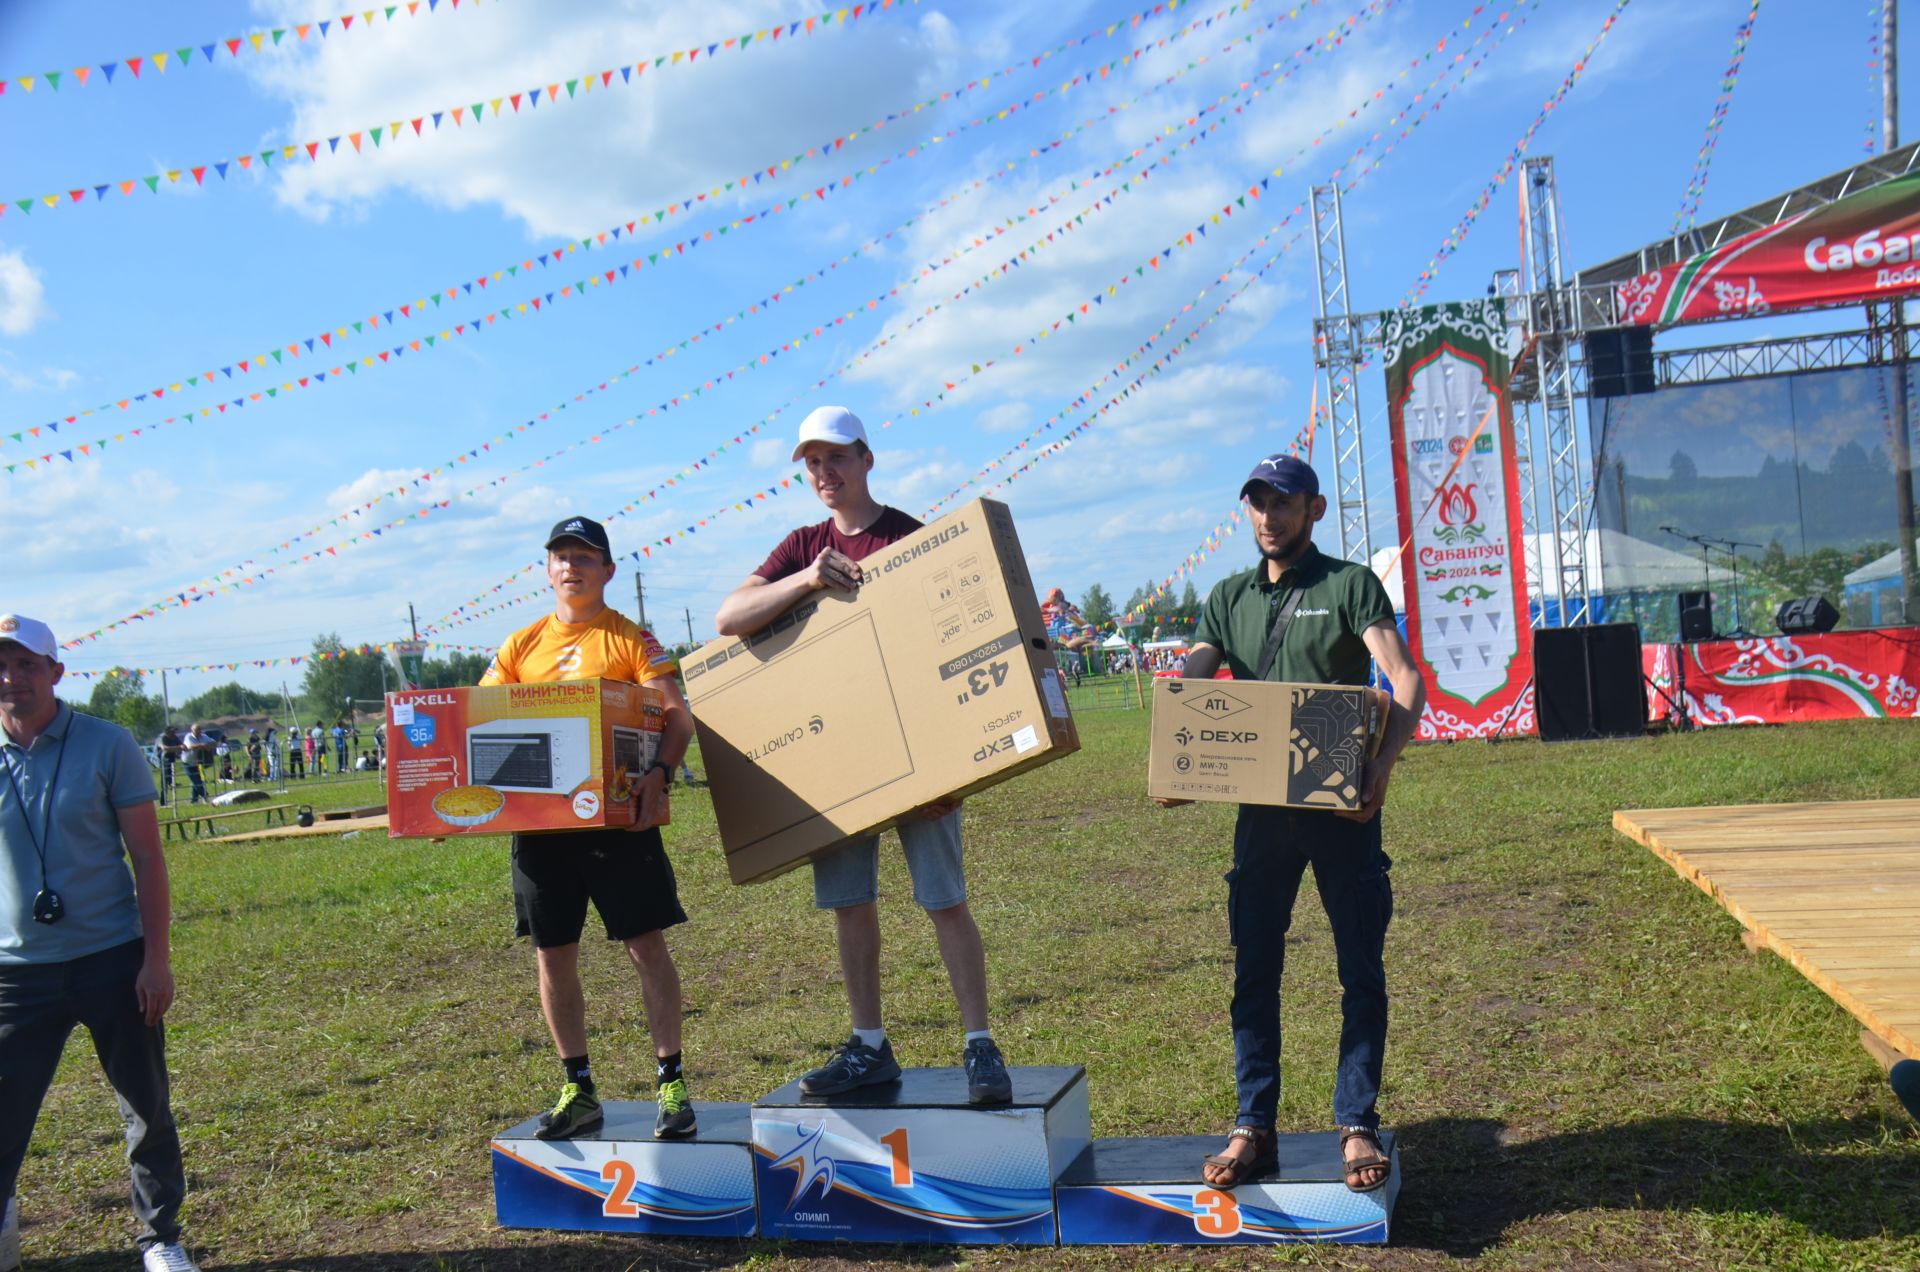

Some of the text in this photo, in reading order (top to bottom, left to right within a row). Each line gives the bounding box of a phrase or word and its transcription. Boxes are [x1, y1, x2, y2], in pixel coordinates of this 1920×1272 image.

[883, 520, 969, 573] ТЕЛЕВИЗОР
[1419, 537, 1504, 567] Сабантуй
[862, 566, 881, 584] LE
[1450, 566, 1477, 578] 2024
[971, 608, 995, 625] 100+
[948, 641, 1004, 673] 1920x1080
[957, 661, 1009, 705] 43"
[511, 695, 596, 708] ЭЛЕКТРИЧЕСКАЯ
[1205, 698, 1229, 711] ATL
[983, 709, 1022, 734] 43FCS1
[762, 727, 804, 756] САЛЮТ
[973, 734, 1015, 762] EXP
[1200, 730, 1258, 743] DEXP
[1200, 762, 1228, 770] MW-70
[880, 1128, 913, 1187] 1
[601, 1159, 639, 1217] 2
[794, 1212, 830, 1223] ОЛИМП
[1193, 1189, 1242, 1237] 3
